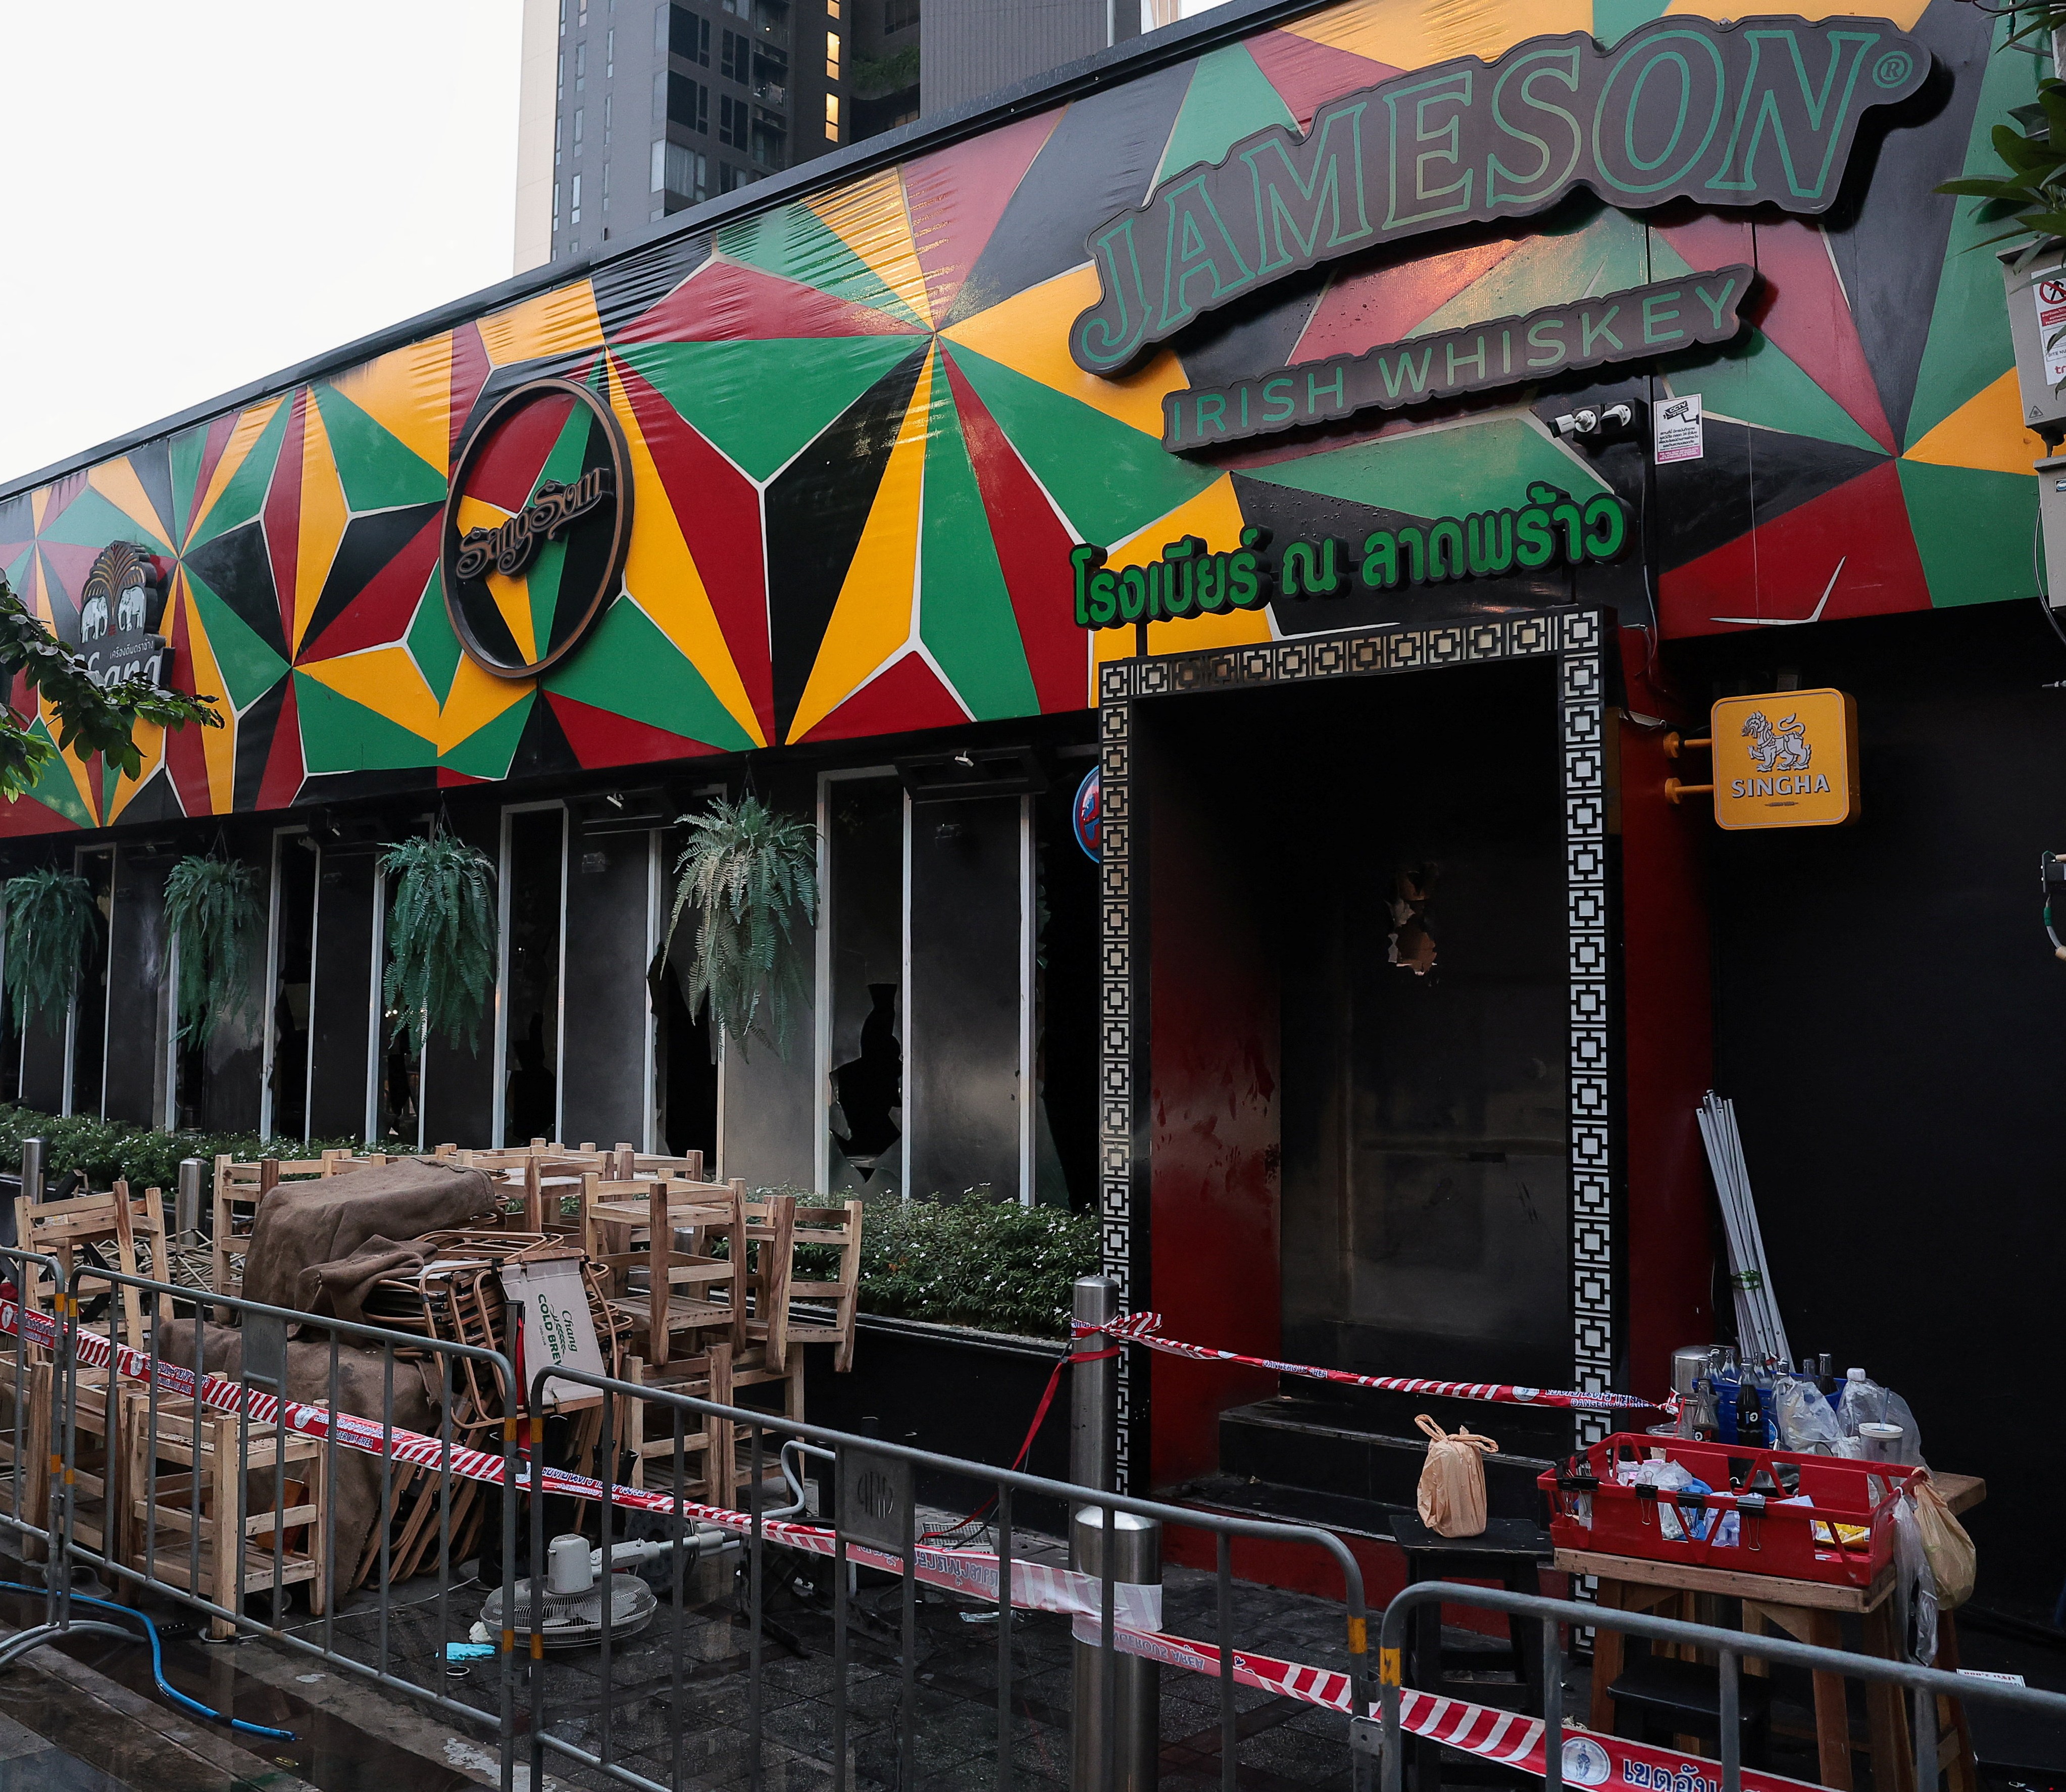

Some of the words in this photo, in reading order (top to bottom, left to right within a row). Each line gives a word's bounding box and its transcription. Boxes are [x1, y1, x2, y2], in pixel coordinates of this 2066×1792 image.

[1079, 29, 1880, 365] JAMESON
[1174, 366, 1345, 438] IRISH
[1382, 279, 1738, 396] WHISKEY
[1669, 402, 1687, 413] CCTV
[1075, 528, 1257, 625] โรงเบียร์
[1283, 541, 1337, 596] ณ
[1363, 483, 1624, 587] ลาดพร้าว
[1731, 774, 1830, 799] SINGHA
[538, 1293, 553, 1331] COLD
[562, 1310, 578, 1352] Chang
[1263, 1360, 1308, 1373] DANGEROUS
[1308, 1368, 1328, 1378] AREA
[1571, 1399, 1627, 1408] DANGEROUS
